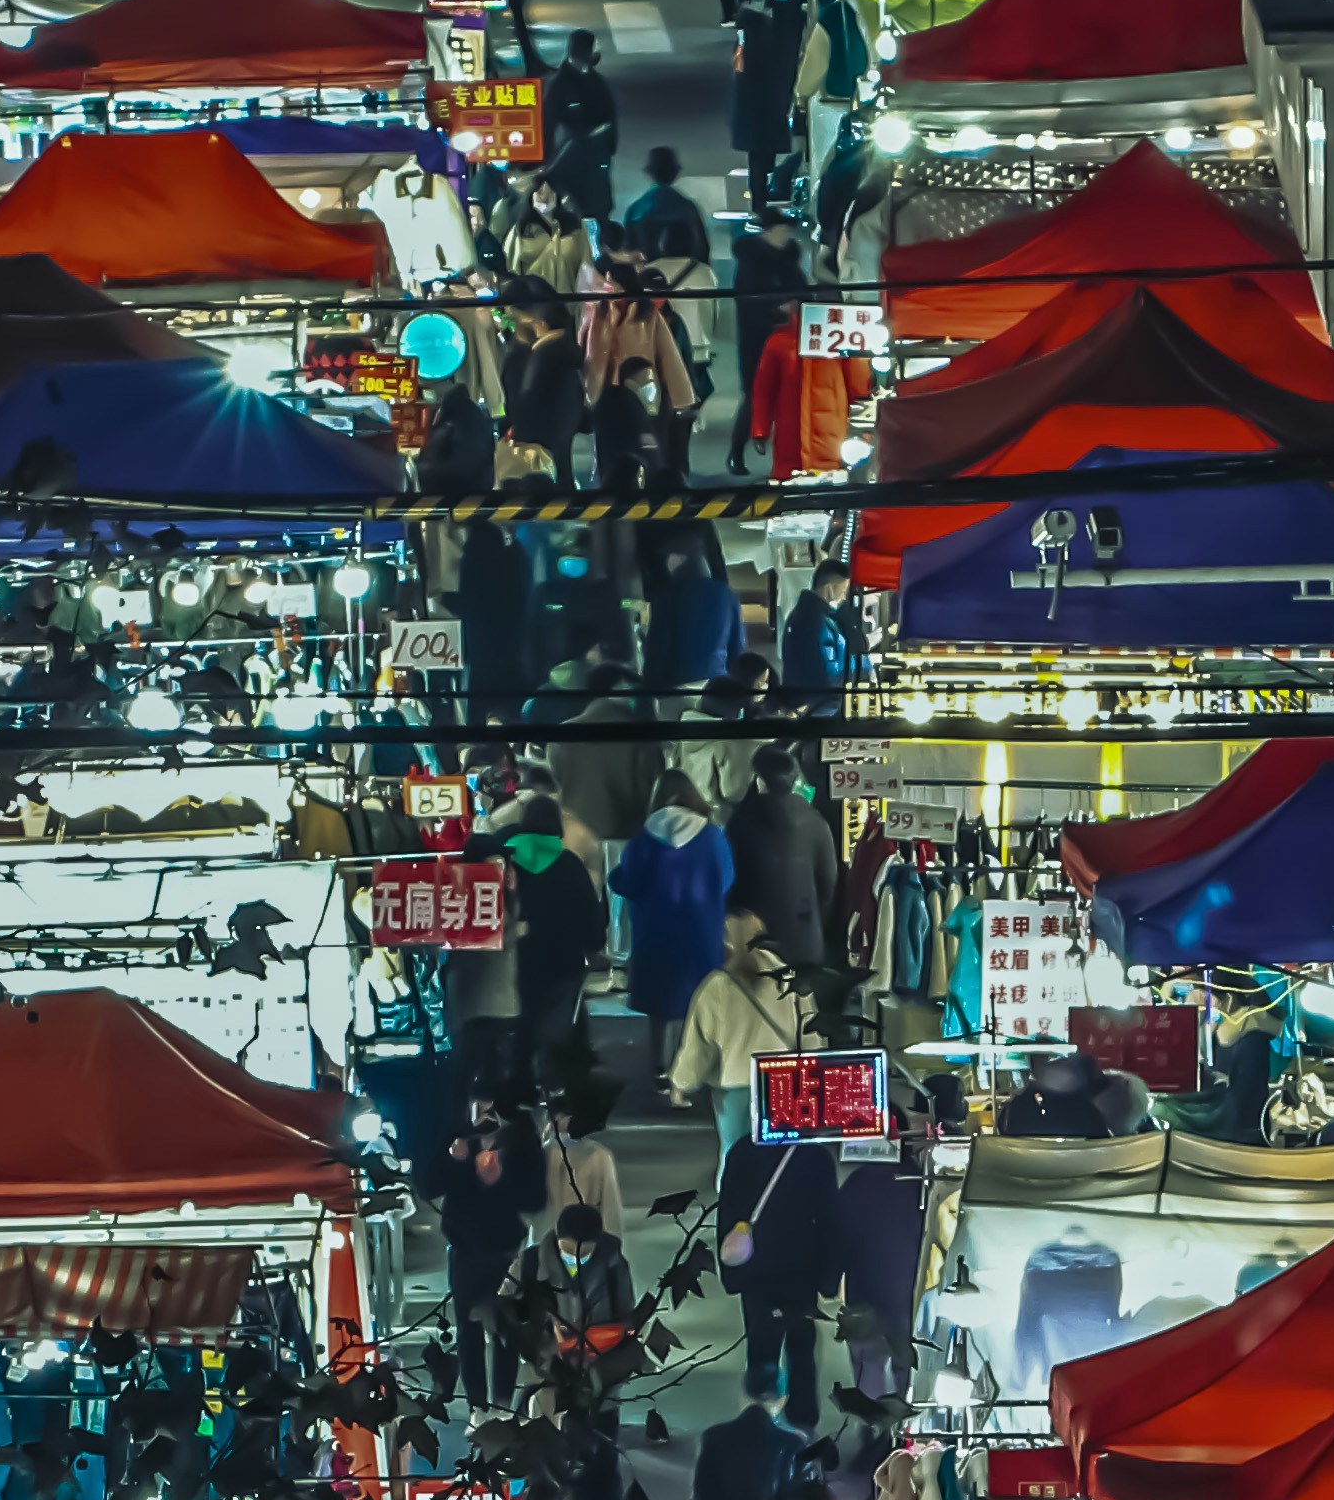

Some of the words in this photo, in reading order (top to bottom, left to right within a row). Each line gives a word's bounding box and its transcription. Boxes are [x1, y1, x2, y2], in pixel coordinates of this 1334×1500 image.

[451, 84, 536, 107] 专业贴膜
[828, 308, 870, 325] 美甲
[828, 330, 865, 353] 29
[833, 771, 860, 788] 99
[419, 787, 454, 814] 85
[888, 811, 913, 830] 99
[375, 881, 500, 930] 无痛穿耳
[990, 916, 1030, 937] 美甲
[989, 949, 1029, 970] 纹眉
[769, 1064, 875, 1129] 贴膜
